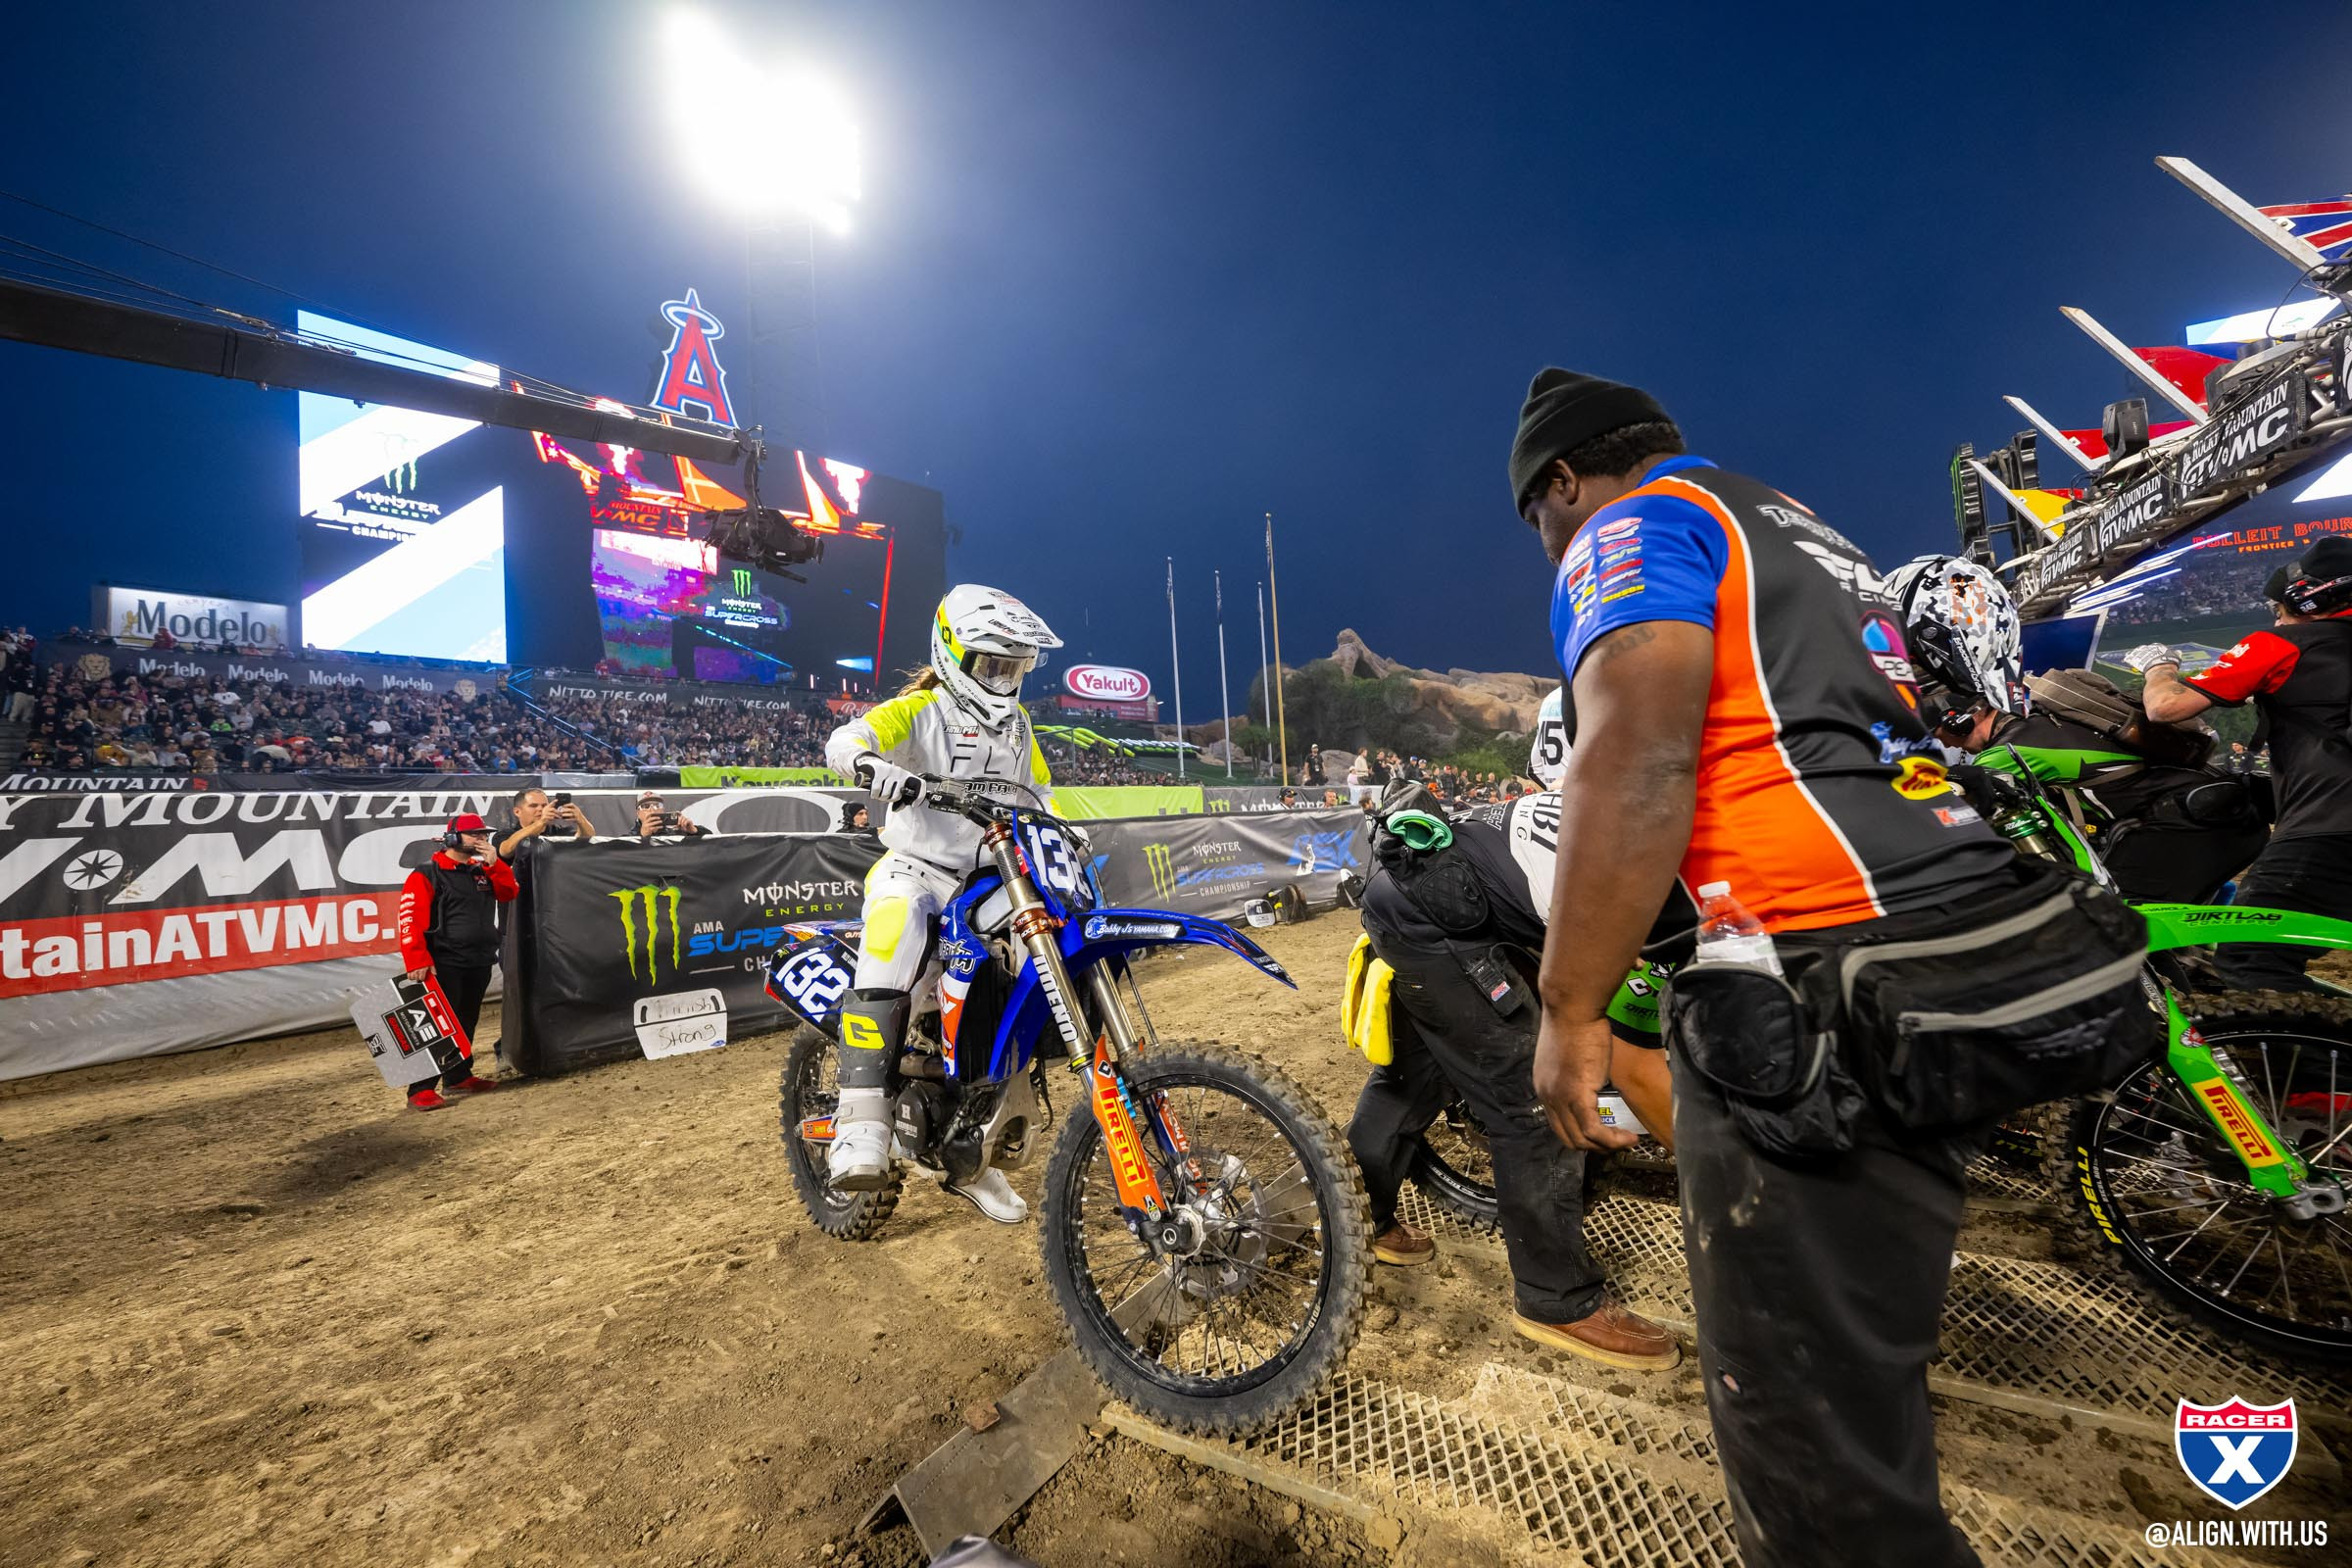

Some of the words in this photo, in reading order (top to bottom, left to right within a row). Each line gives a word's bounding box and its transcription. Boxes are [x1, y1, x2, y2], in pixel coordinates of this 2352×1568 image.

[356, 490, 441, 515] MONSTER
[137, 599, 268, 644] Modelo
[139, 659, 206, 677] Modelo
[228, 664, 289, 683] Modelo
[309, 669, 365, 687] Modelo
[382, 674, 433, 692] Modelo
[1082, 673, 1138, 693] Yakult
[950, 743, 1024, 775] FLY
[58, 792, 496, 829] MOUNTAIN
[1193, 841, 1242, 858] MONSTER
[743, 880, 859, 905] MONSTER
[1200, 881, 1250, 898] CHAMPIONSHIP
[765, 903, 845, 917] ENERGY
[2181, 911, 2284, 922] DIRTLAB
[693, 920, 725, 935] AMA
[775, 947, 851, 1023] 132
[659, 1024, 716, 1051] Strong
[2204, 1085, 2272, 1159] PIRELLI
[1099, 1087, 1148, 1187] PIRELLI
[2078, 1147, 2123, 1245] PIRELLI
